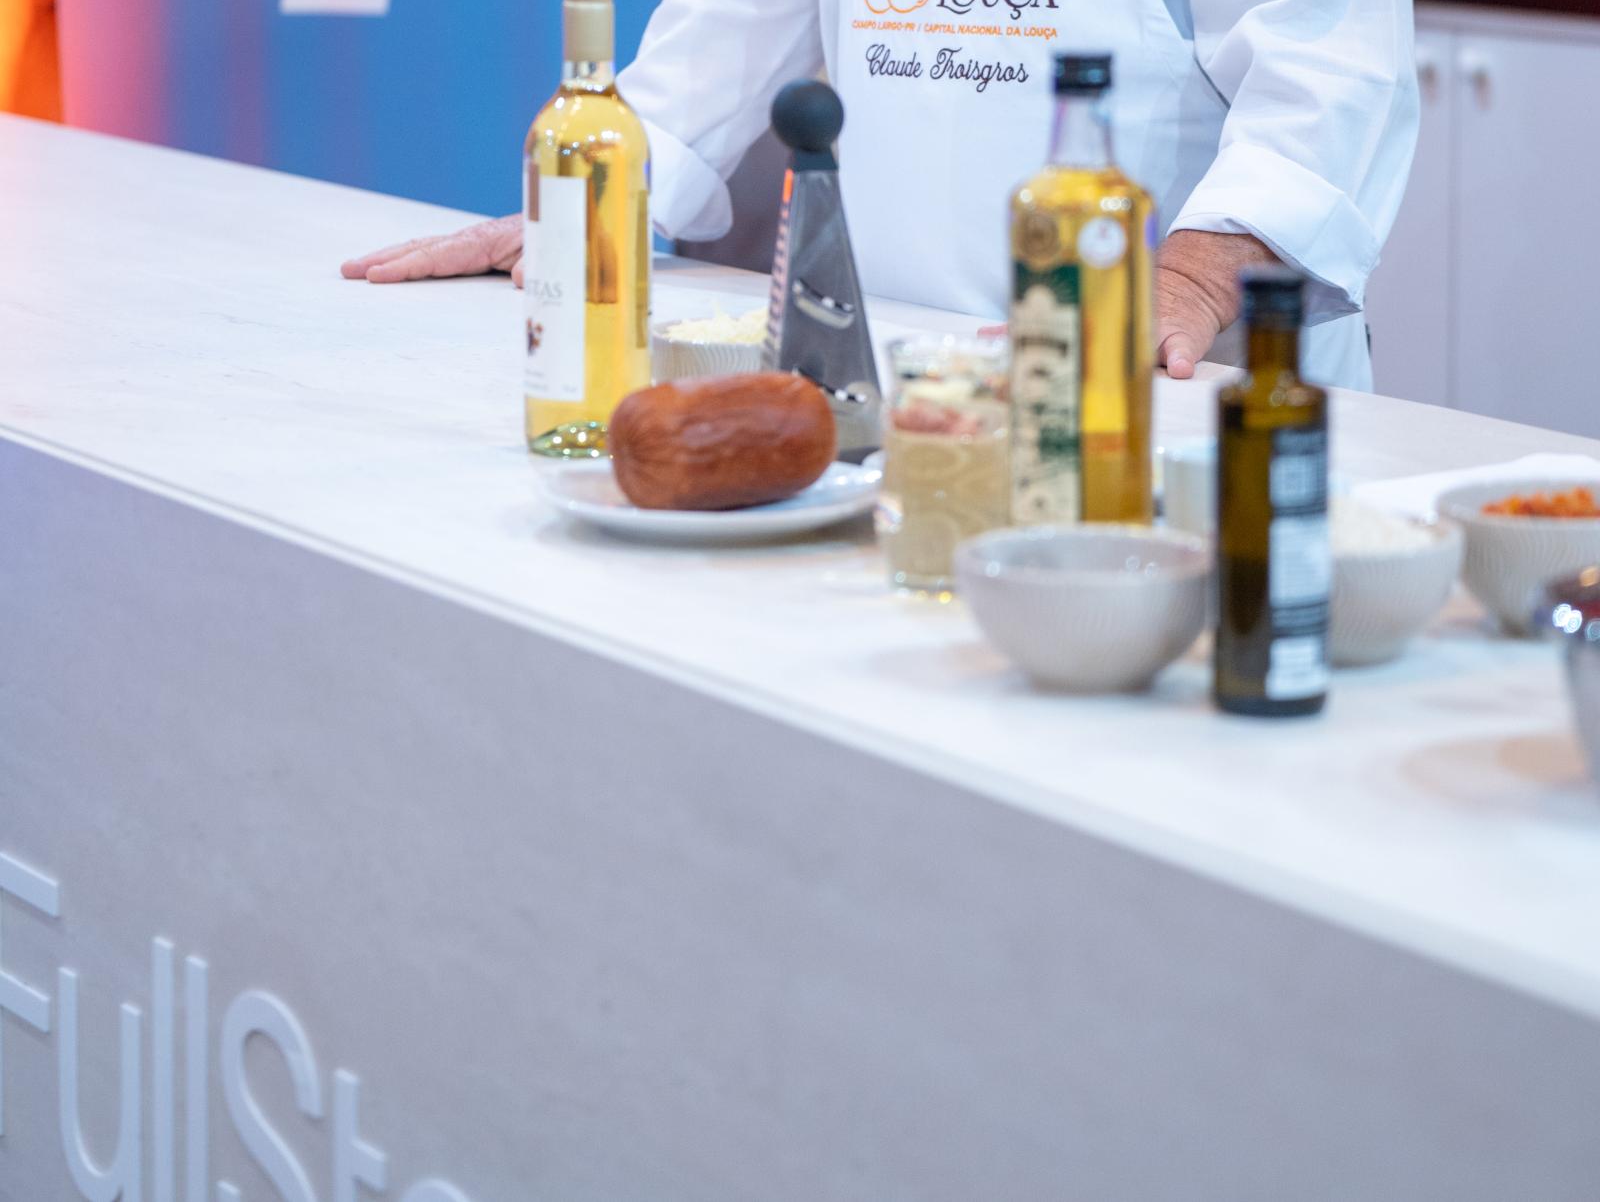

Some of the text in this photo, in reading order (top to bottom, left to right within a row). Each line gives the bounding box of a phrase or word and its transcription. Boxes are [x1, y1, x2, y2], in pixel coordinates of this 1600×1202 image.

[924, 22, 955, 34] CAPITAL
[957, 24, 1002, 36] NACIONAL
[1006, 26, 1021, 36] DA
[1024, 27, 1058, 40] LOUÇA
[865, 44, 1029, 92] Claude Troisgros
[0, 852, 472, 1202] FullSt
